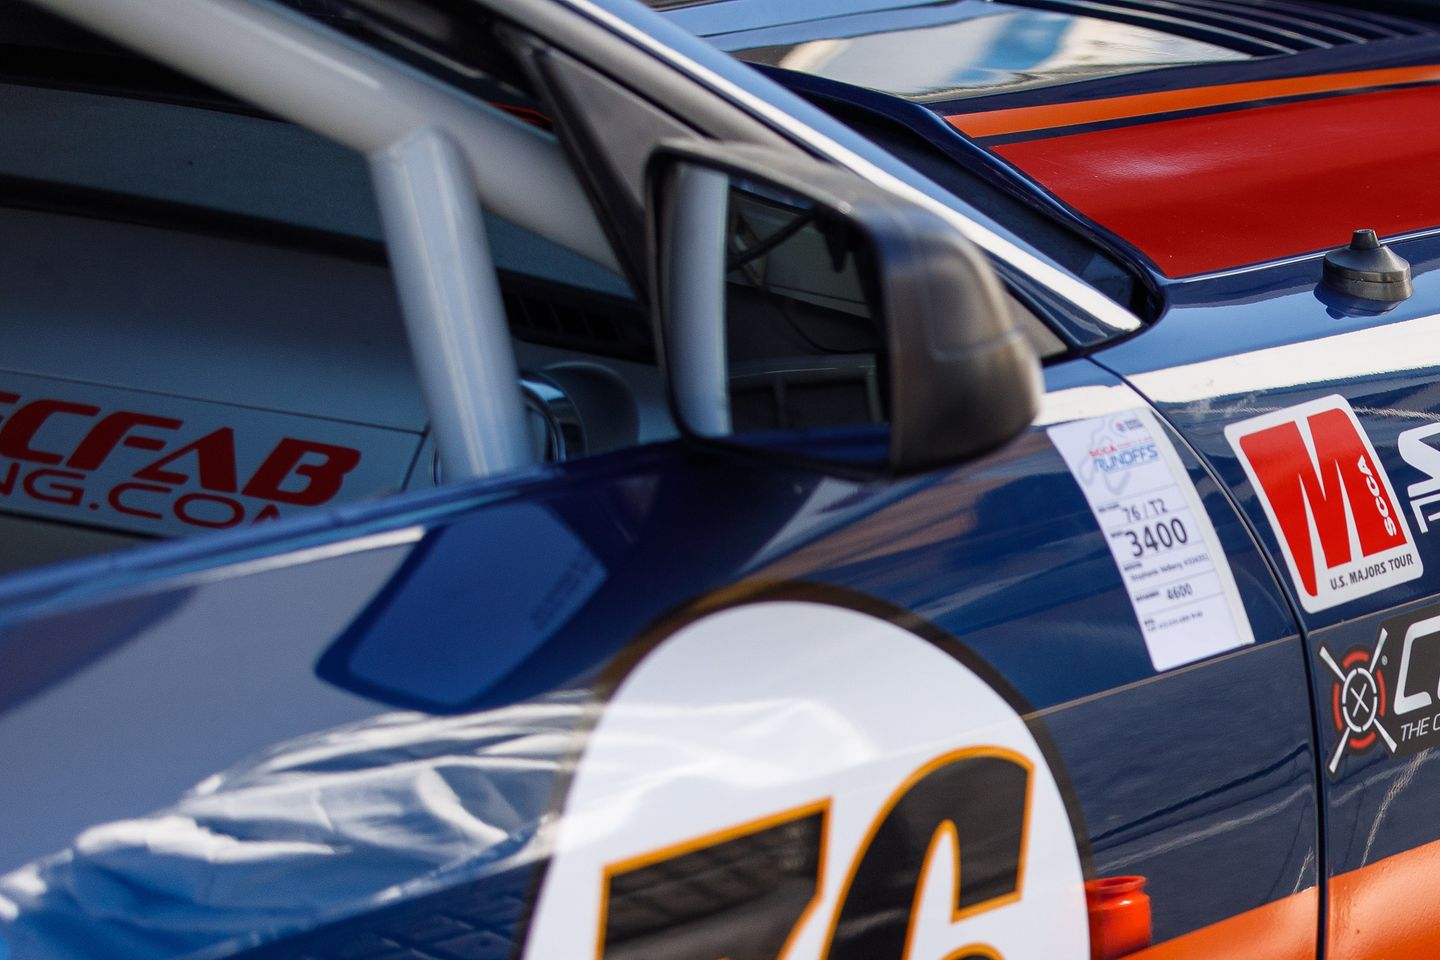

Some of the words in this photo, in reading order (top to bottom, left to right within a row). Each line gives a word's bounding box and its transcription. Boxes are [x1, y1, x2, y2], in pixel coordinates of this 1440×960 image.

[0, 462, 281, 529] G.CO
[1123, 507, 1141, 523] 76
[1149, 498, 1168, 516] T2
[1356, 454, 1397, 538] SCCA
[1125, 517, 1187, 557] 3400
[1330, 575, 1348, 591] U.S.
[1349, 562, 1387, 585] MAJORS
[1388, 554, 1413, 573] TOUR
[1401, 716, 1430, 742] THE
